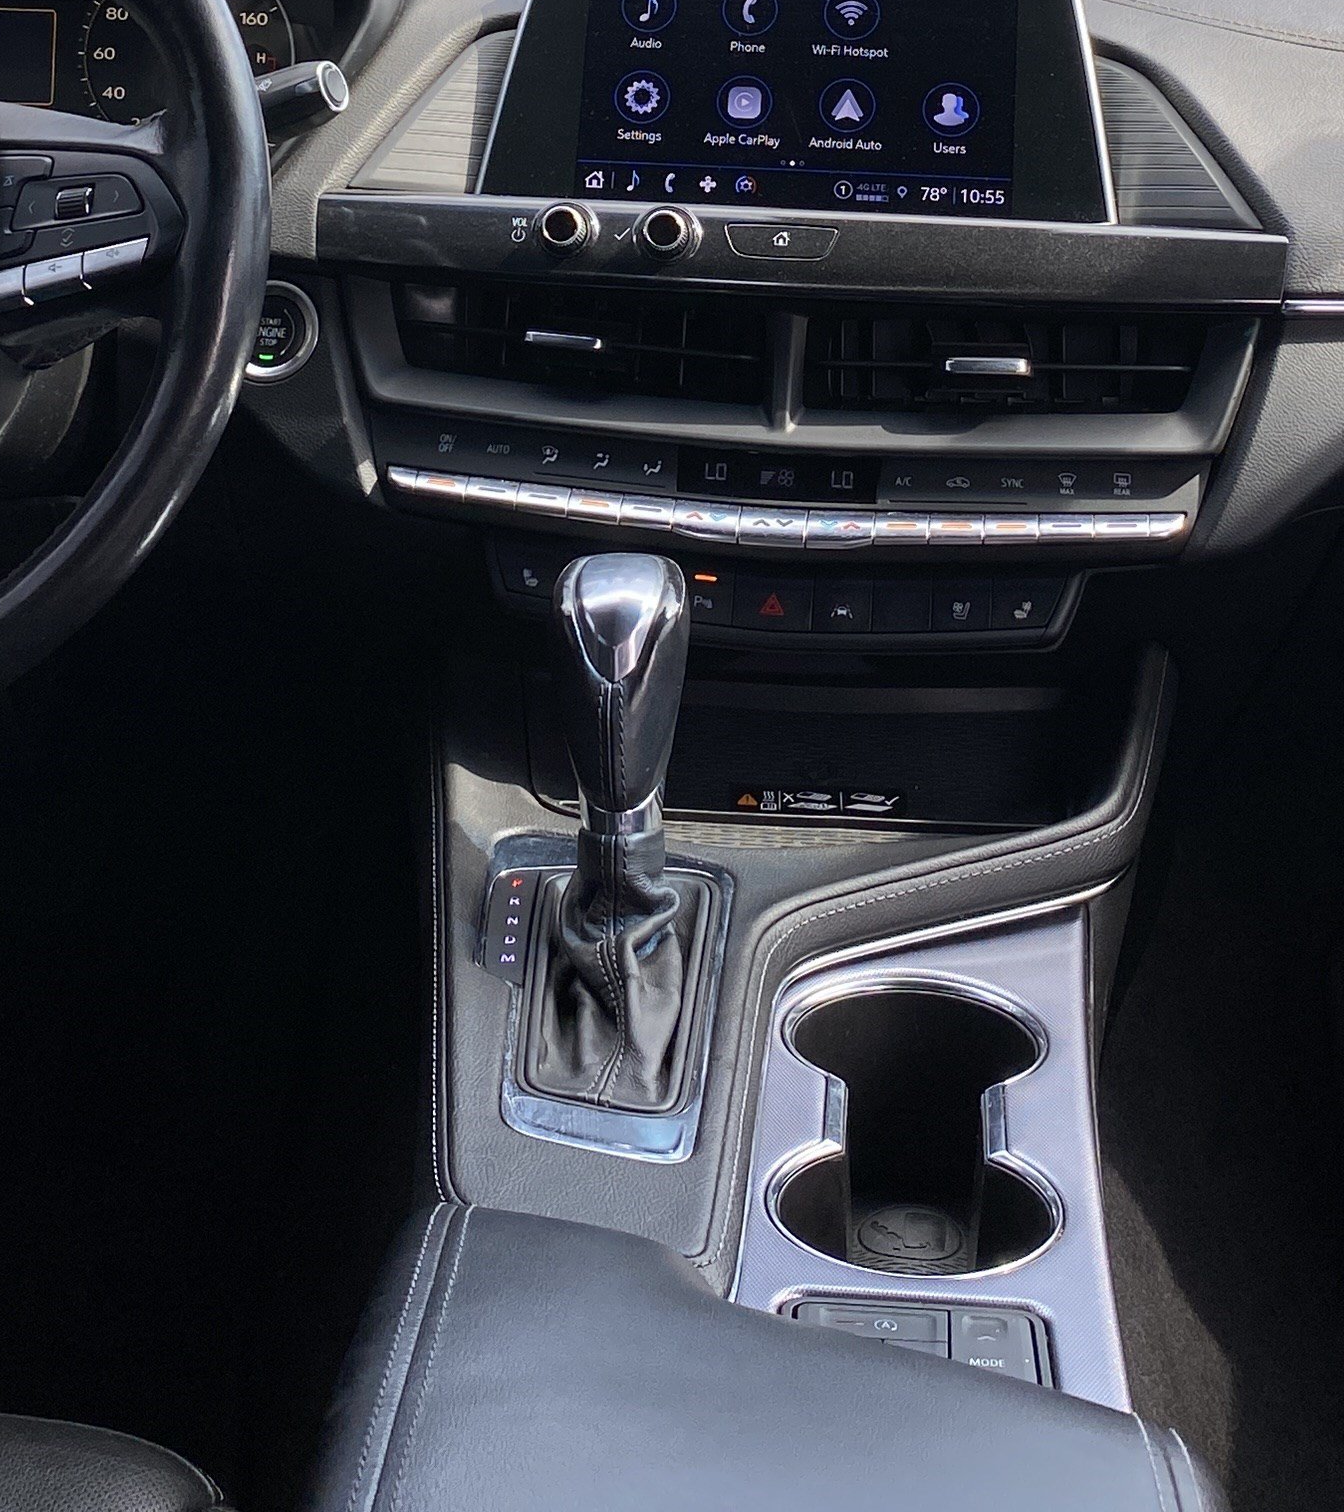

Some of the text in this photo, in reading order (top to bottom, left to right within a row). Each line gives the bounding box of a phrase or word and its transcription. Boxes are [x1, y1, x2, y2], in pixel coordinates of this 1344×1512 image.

[105, 7, 129, 22] 80
[239, 11, 269, 27] 160
[629, 37, 663, 50] Audio
[729, 40, 766, 55] Phone
[93, 46, 116, 61] 60
[255, 51, 266, 64] H
[811, 43, 889, 60] Wi-Fi Hotspot
[102, 86, 126, 101] 40
[616, 128, 662, 144] Settings
[704, 132, 781, 150] Apple CarPlay
[808, 136, 883, 152] Android Auto
[932, 141, 967, 156] Users
[856, 183, 888, 192] 4G LTE
[920, 186, 948, 202] 78°
[959, 187, 1006, 205] 10:55
[511, 215, 528, 228] VOL
[260, 317, 283, 326] START
[257, 326, 287, 339] NGINE
[258, 338, 279, 347] STOP
[439, 433, 457, 444] ON/
[437, 442, 455, 454] OFF
[486, 443, 511, 455] AUTO
[704, 463, 728, 482] LO
[830, 470, 854, 490] LO
[894, 475, 913, 488] A/C
[1000, 477, 1025, 489] SYNC
[1059, 488, 1075, 496] MAX
[1113, 488, 1131, 496] REAR
[509, 896, 521, 906] R
[506, 916, 519, 926] N
[504, 935, 516, 945] D
[500, 953, 516, 963] M
[969, 1357, 1006, 1369] MODE
